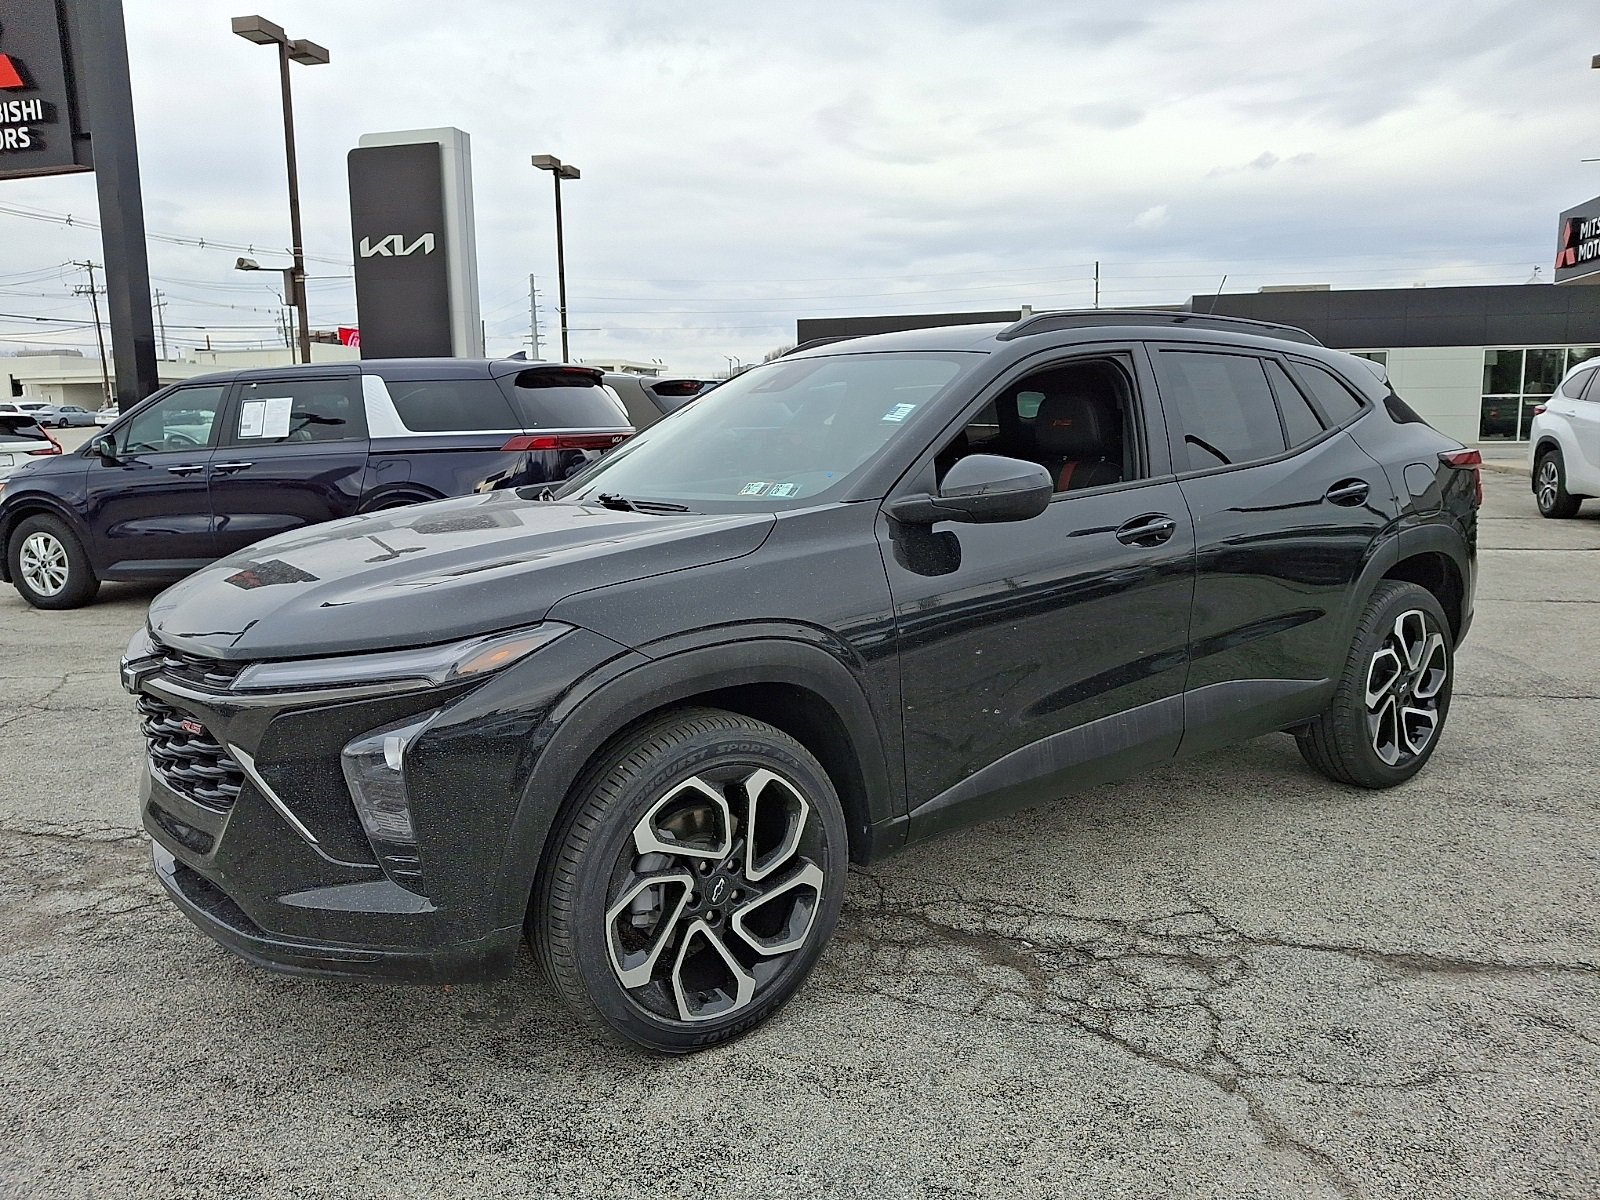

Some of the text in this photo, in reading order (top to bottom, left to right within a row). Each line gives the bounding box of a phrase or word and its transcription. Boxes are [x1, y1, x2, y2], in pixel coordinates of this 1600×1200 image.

[0, 99, 43, 123] ISHI
[360, 233, 435, 258] KIA
[181, 719, 204, 737] RS
[622, 748, 709, 818] CONQUEST
[716, 743, 771, 755] SPORT
